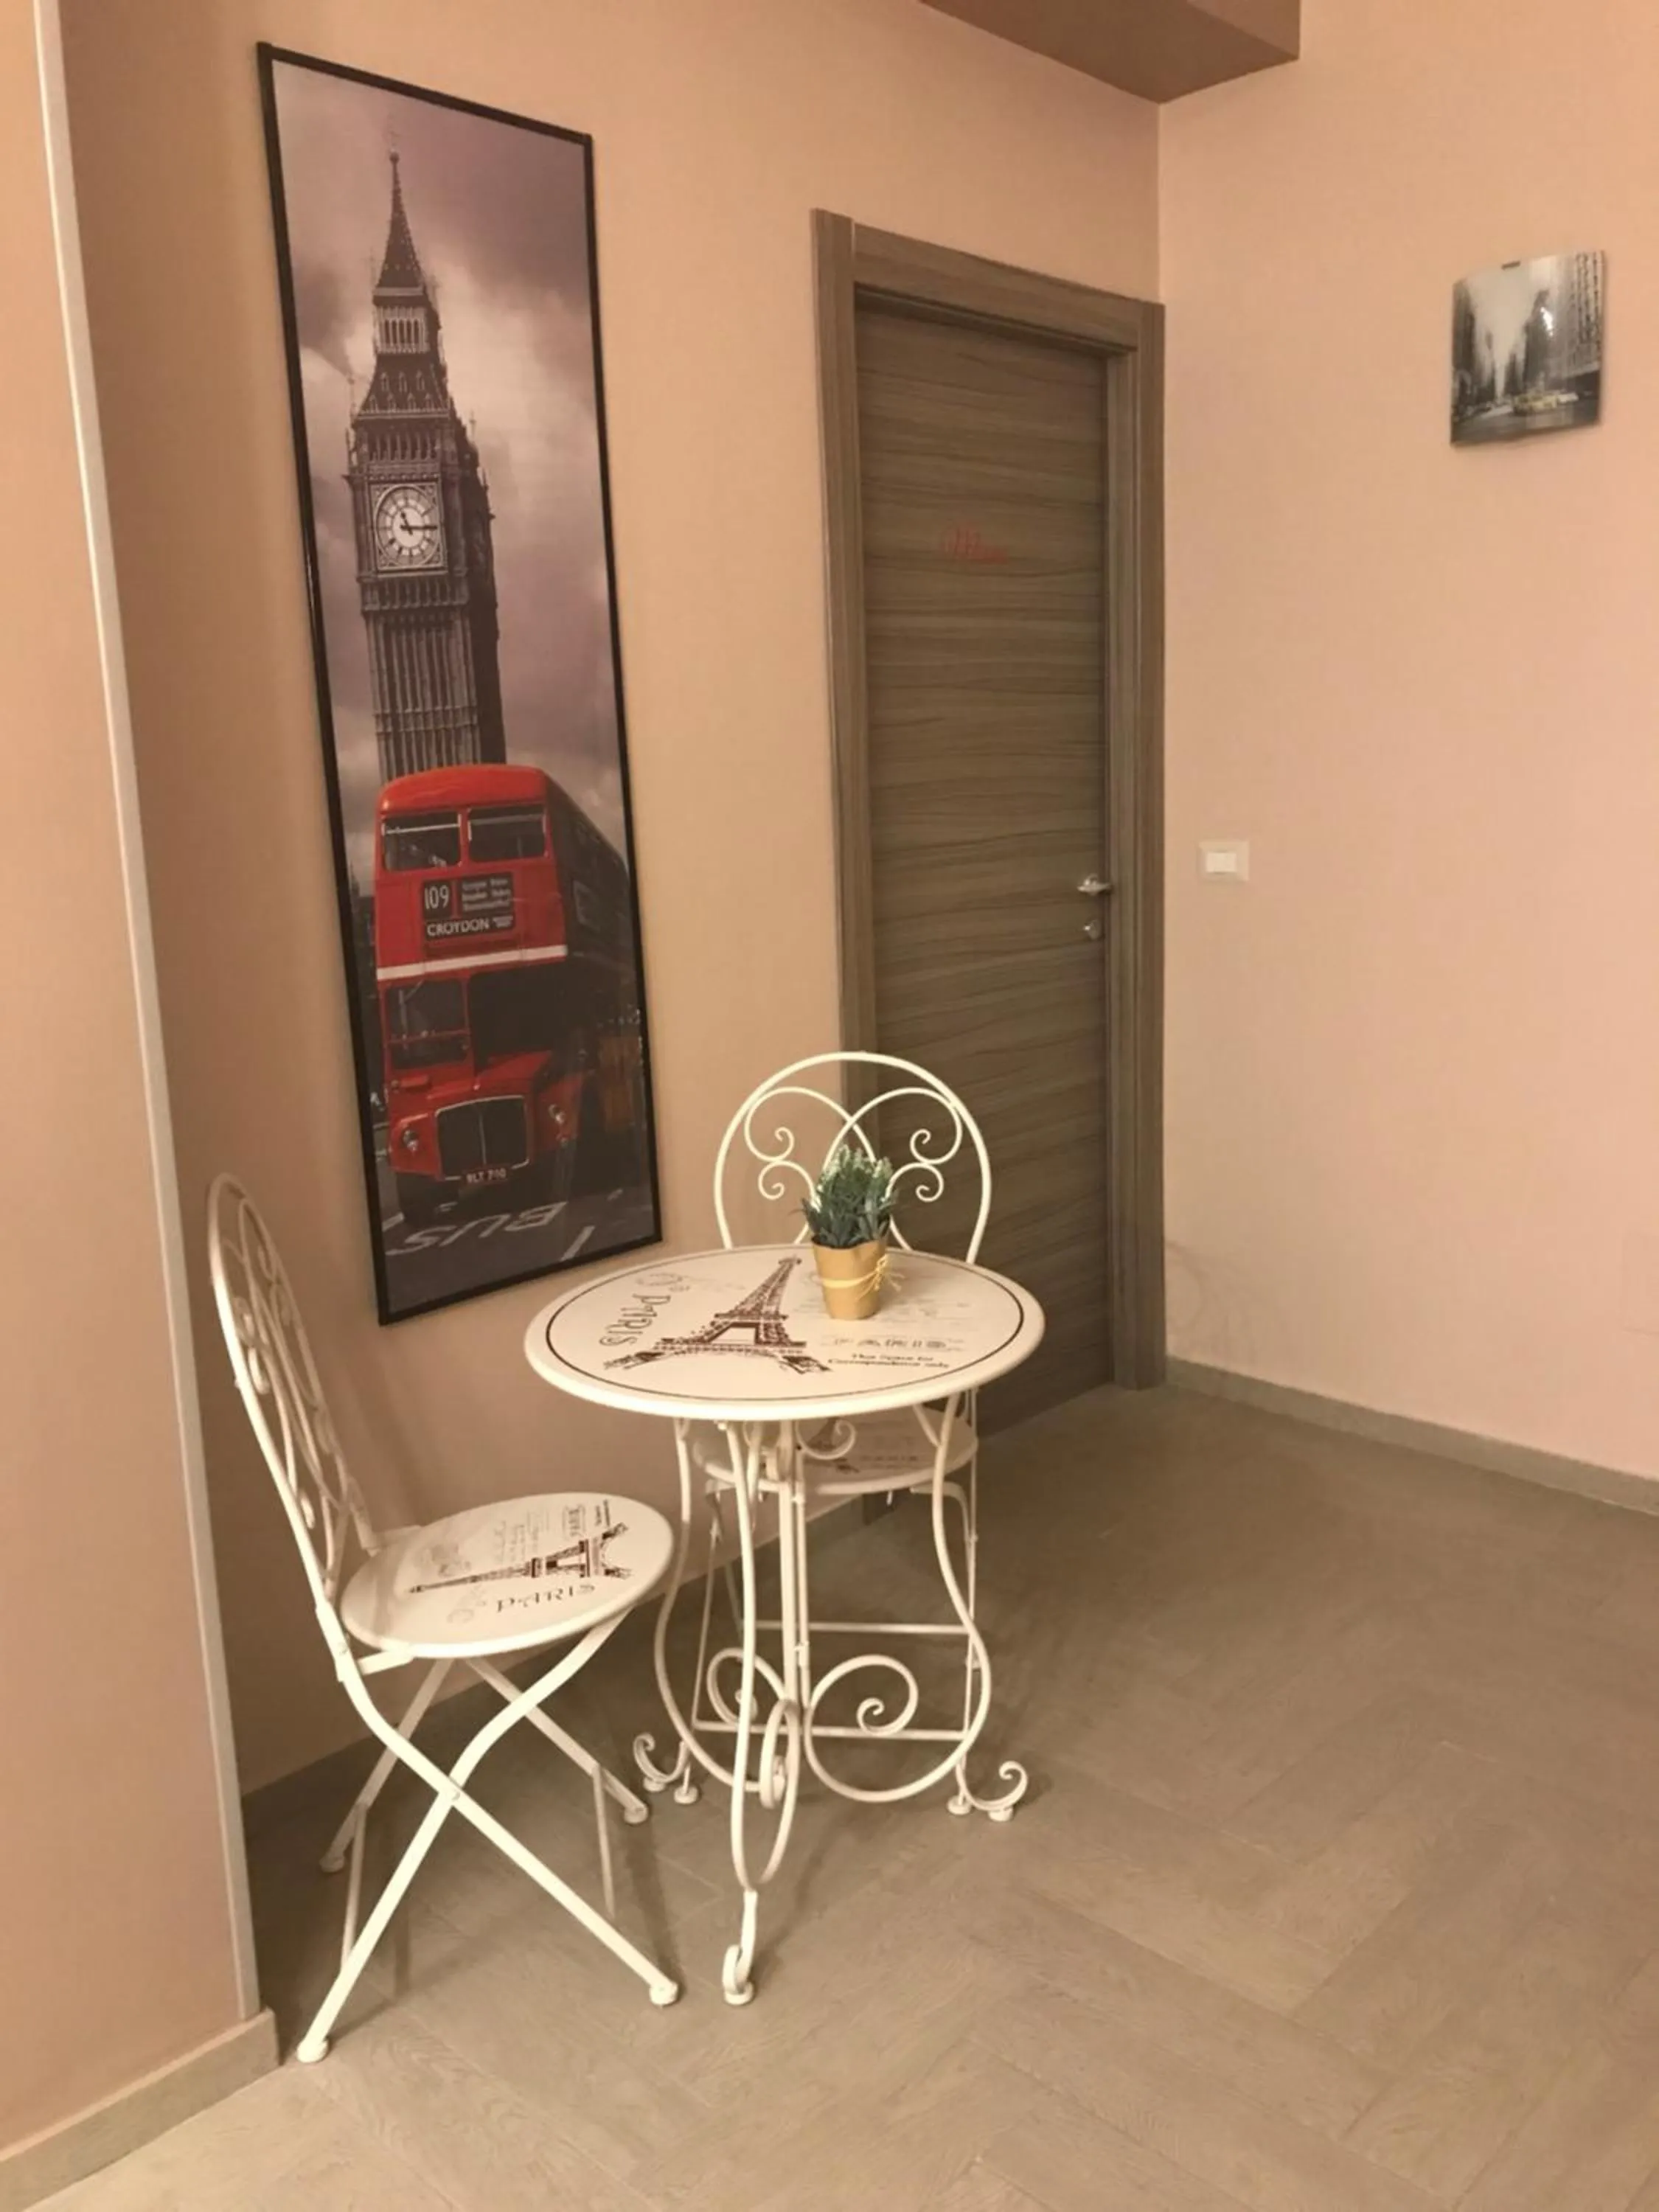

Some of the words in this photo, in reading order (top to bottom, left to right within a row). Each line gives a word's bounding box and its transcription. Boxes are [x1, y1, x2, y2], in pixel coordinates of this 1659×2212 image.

[424, 884, 450, 910] 109
[427, 917, 490, 937] CROYDON
[385, 1201, 567, 1256] BUS
[599, 1293, 672, 1348] PARIS
[496, 1585, 597, 1613] PARIS
